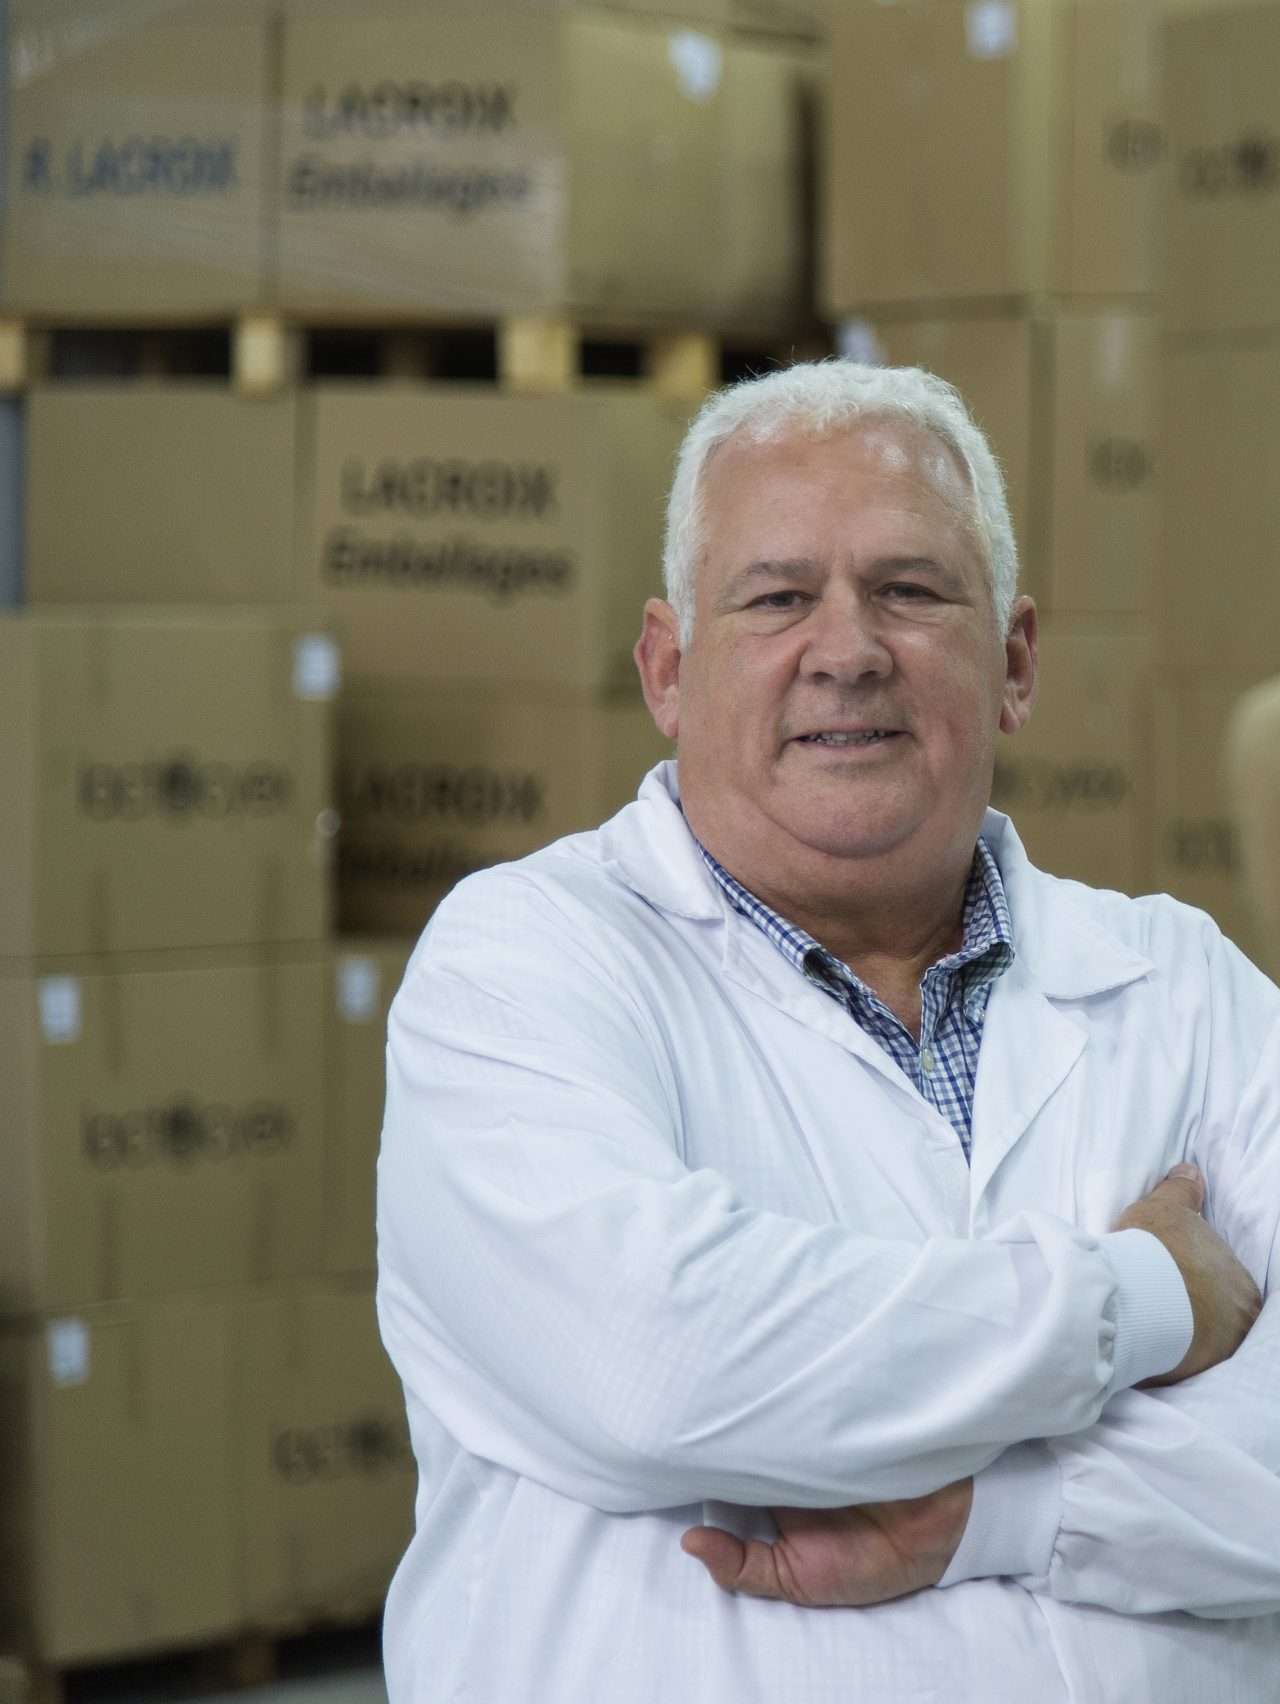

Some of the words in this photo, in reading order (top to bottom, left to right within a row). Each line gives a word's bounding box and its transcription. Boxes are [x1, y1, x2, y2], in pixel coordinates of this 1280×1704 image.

[300, 79, 519, 142] LACROIX
[65, 136, 241, 200] LACROIX
[288, 152, 531, 224] Emballages
[338, 455, 563, 525] LACROIX
[318, 526, 582, 611] Emballages
